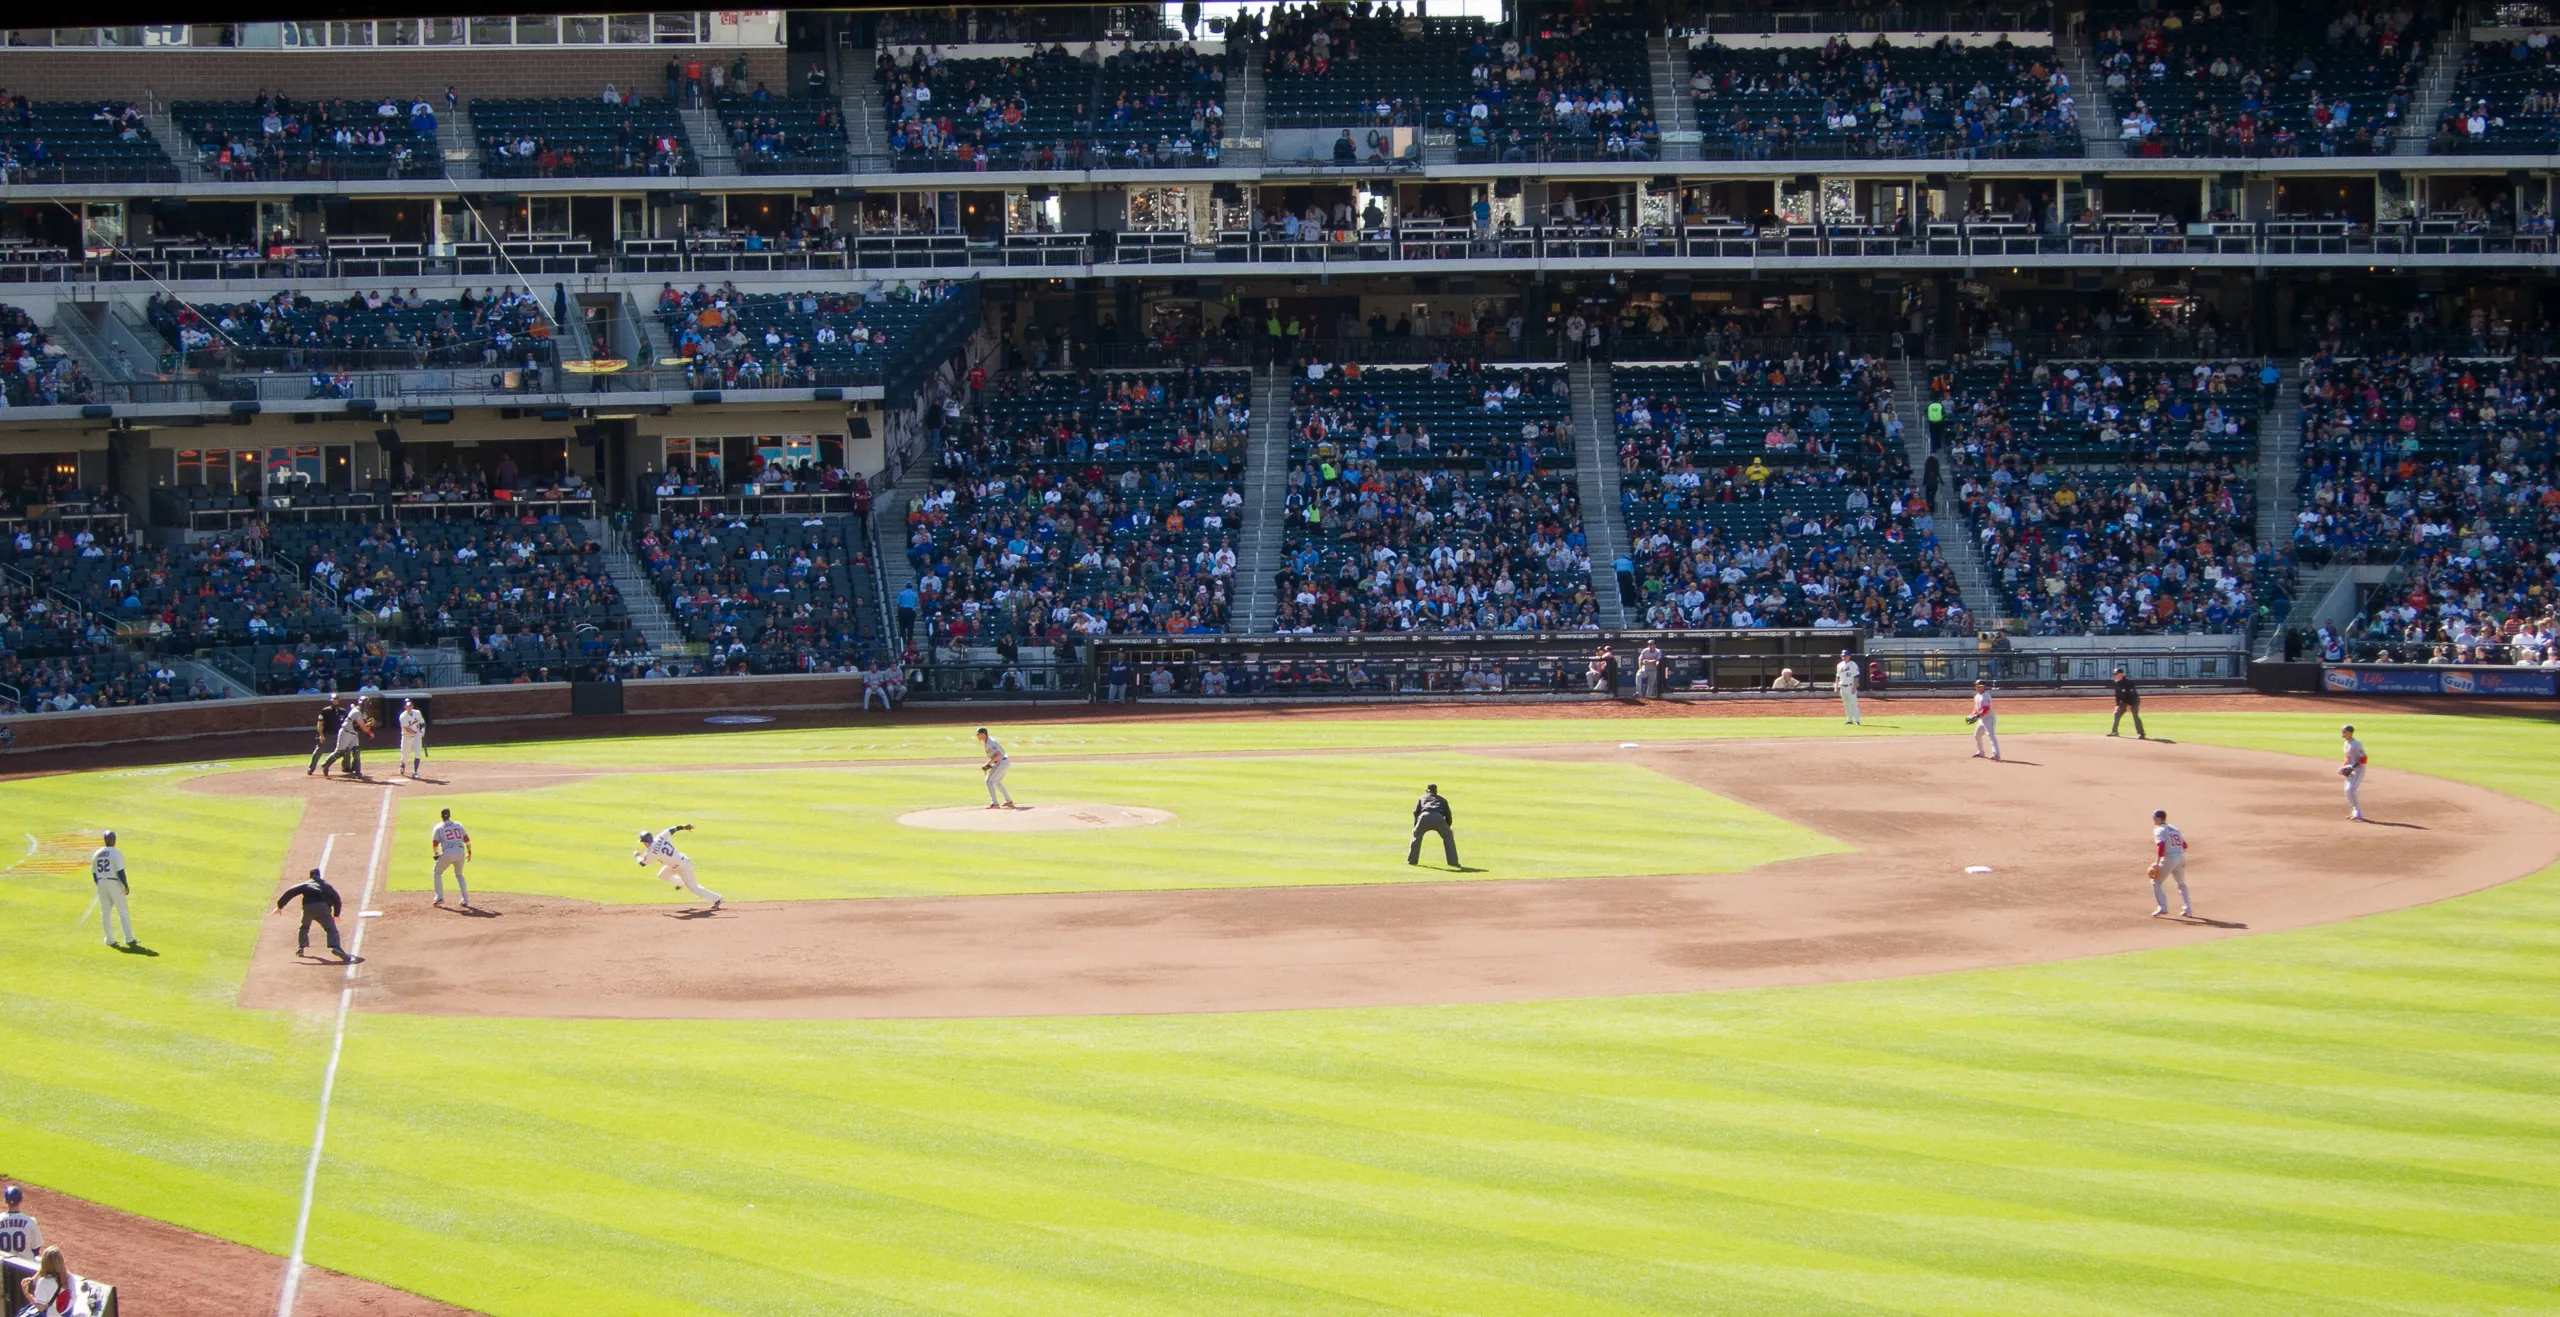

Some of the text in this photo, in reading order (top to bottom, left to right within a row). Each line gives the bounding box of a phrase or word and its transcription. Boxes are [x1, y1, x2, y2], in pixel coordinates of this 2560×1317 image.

[2328, 673, 2356, 688] Gulf
[2444, 676, 2472, 690] Gulf
[445, 828, 462, 841] 20
[661, 841, 675, 857] 27
[97, 859, 110, 873] 52
[0, 1231, 26, 1252] 00
